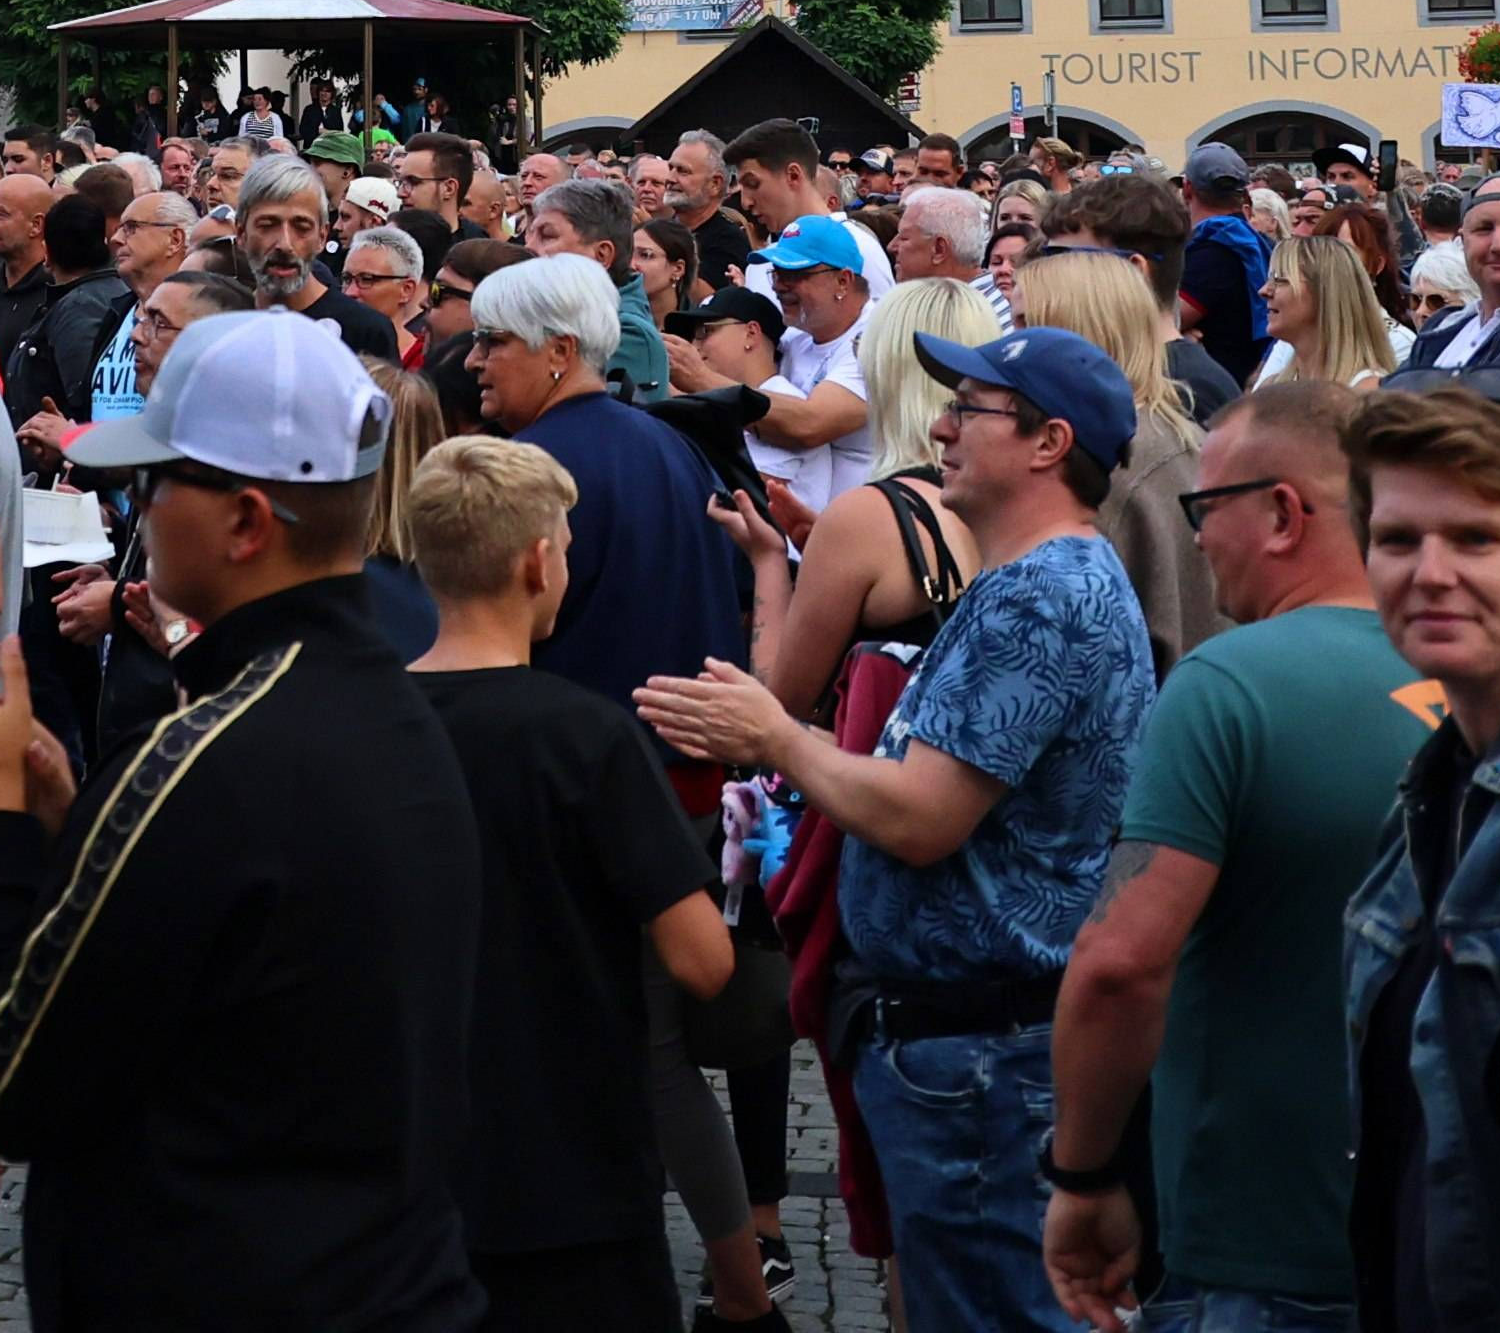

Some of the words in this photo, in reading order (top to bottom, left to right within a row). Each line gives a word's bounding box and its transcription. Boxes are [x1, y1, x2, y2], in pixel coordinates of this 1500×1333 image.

[702, 9, 722, 22] Uhr
[1041, 51, 1202, 85] TOURIST
[1248, 46, 1456, 81] INFORMAT
